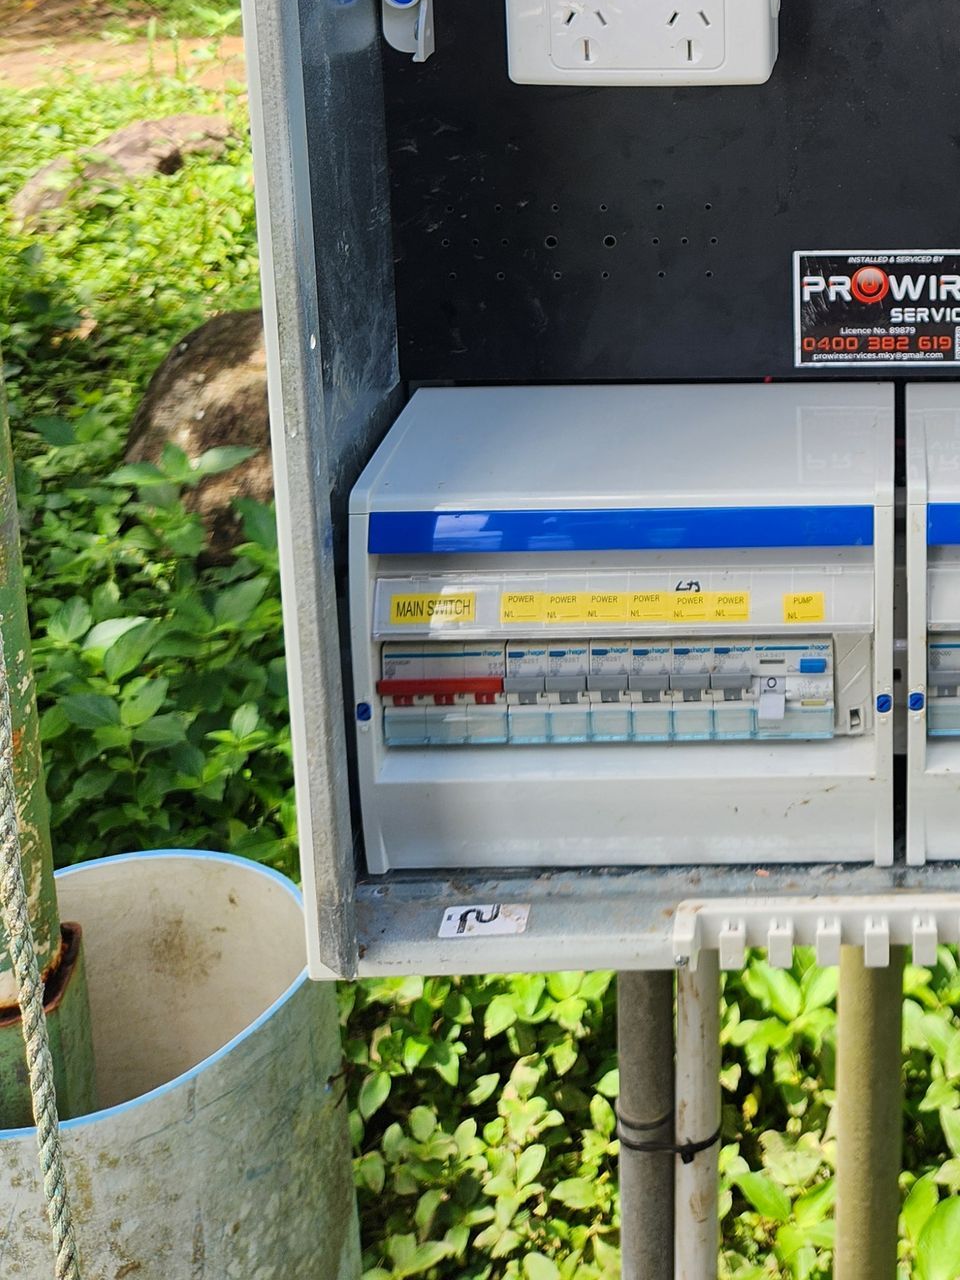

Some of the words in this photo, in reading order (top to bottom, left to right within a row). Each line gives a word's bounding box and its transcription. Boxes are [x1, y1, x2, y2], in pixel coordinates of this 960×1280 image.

[848, 256, 888, 264] INSTALLED
[889, 256, 895, 264] &
[896, 255, 932, 263] SERVICED
[932, 255, 944, 263] BY
[840, 326, 872, 335] Licence
[873, 326, 888, 335] No.
[803, 336, 859, 351] 0400
[868, 336, 909, 350] 382
[918, 336, 952, 350] 619
[508, 595, 534, 603] POWER
[550, 595, 576, 604] POWER
[591, 595, 618, 603] POWER
[633, 594, 660, 602] POWER
[677, 596, 703, 605] POWER
[717, 596, 744, 604] POWER
[396, 601, 424, 617] MAIN
[426, 599, 471, 616] SWITCH
[609, 646, 629, 654] hager
[651, 646, 670, 654] hager
[691, 645, 711, 654] hager
[732, 645, 752, 653] hager
